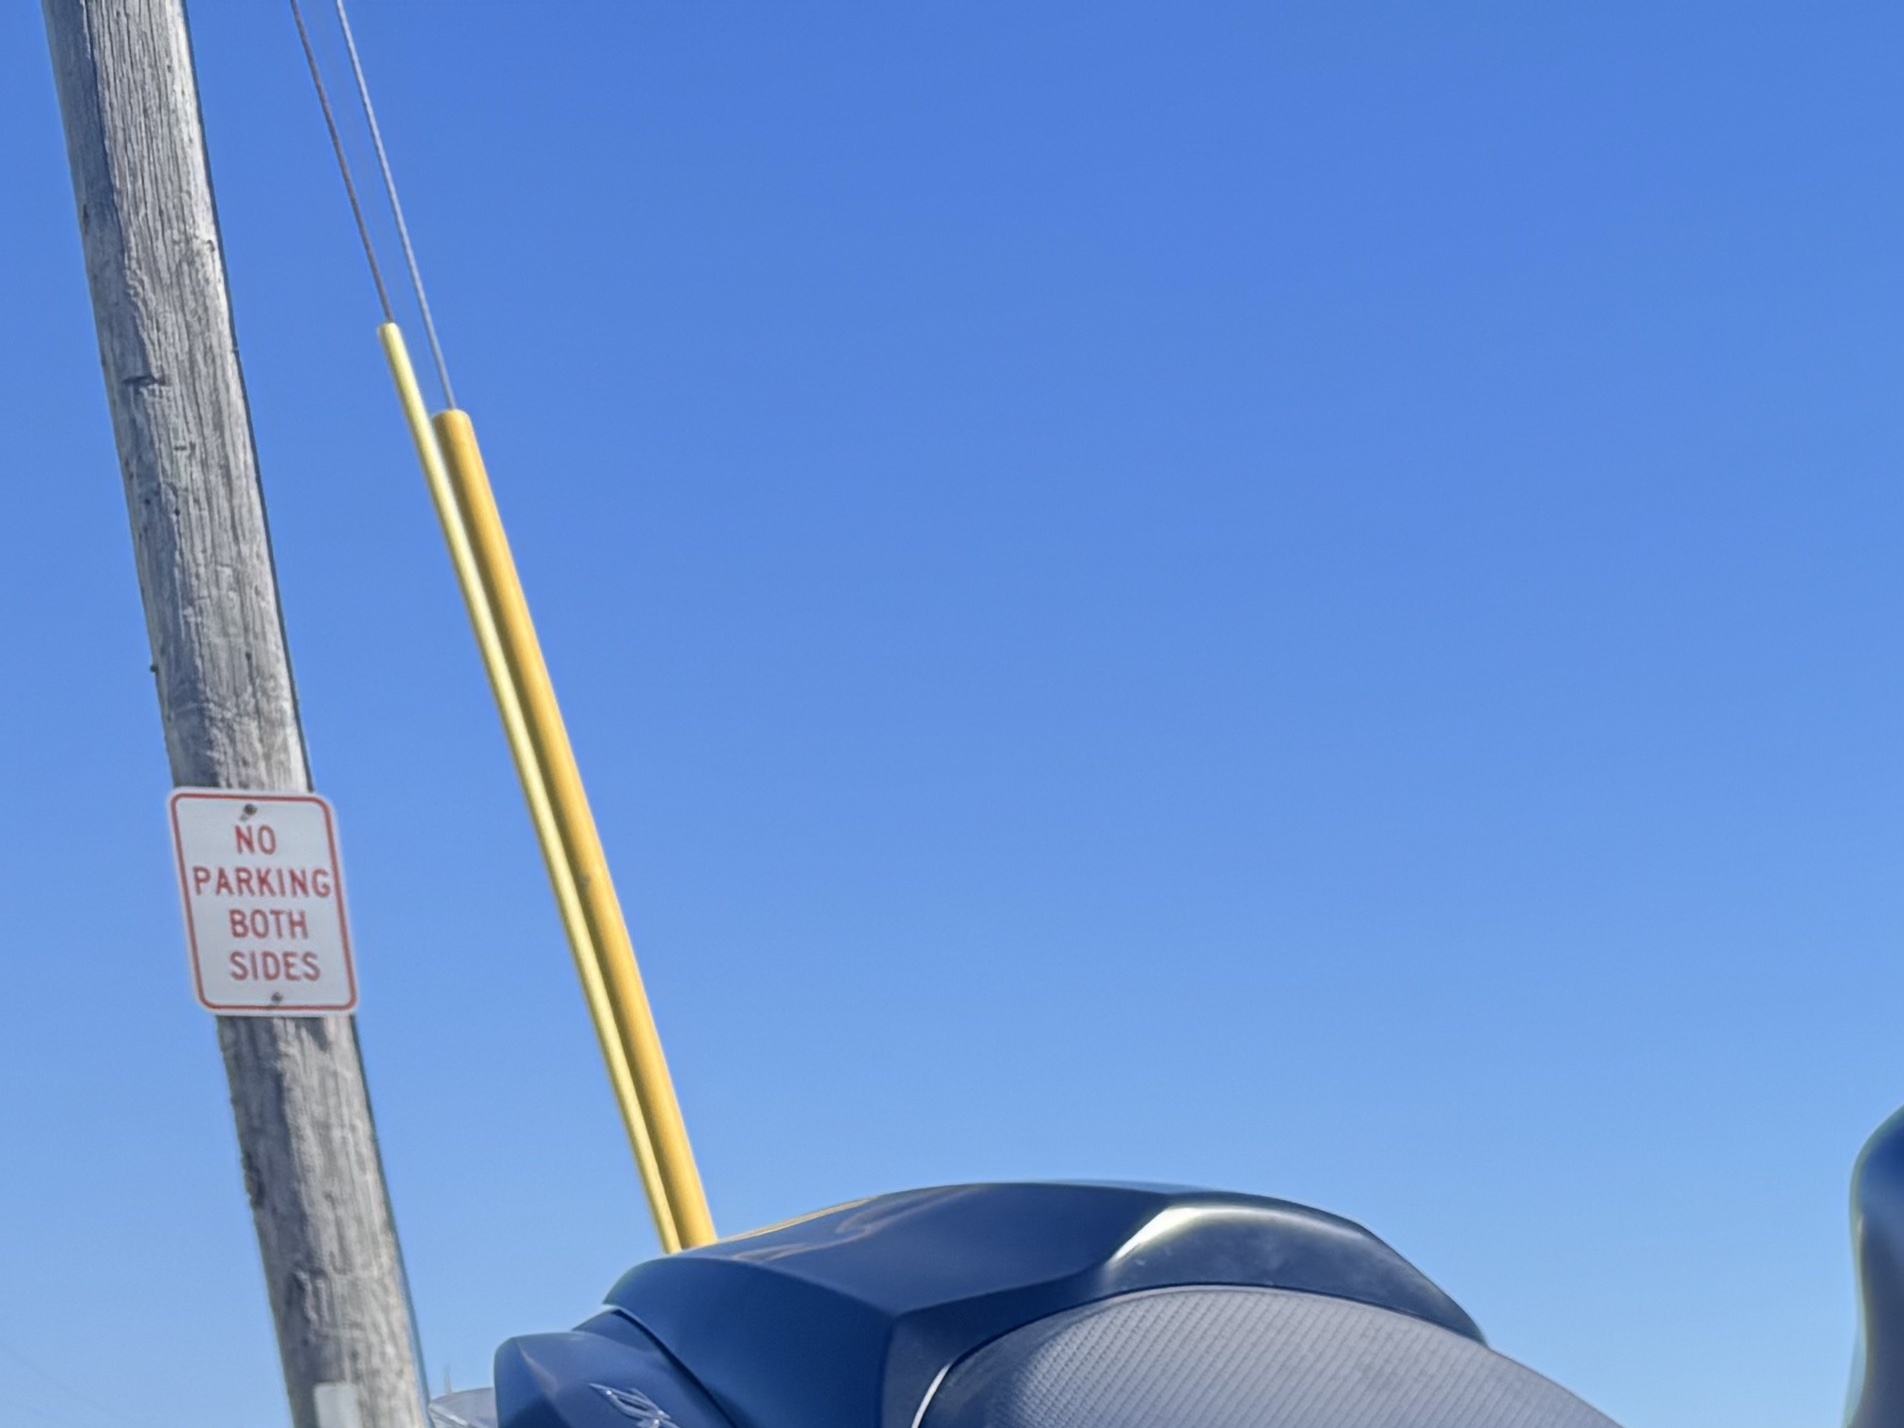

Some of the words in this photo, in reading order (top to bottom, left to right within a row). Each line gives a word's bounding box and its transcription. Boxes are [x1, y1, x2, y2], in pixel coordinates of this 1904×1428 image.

[234, 825, 277, 855] NO
[192, 866, 332, 898] PARKING
[228, 909, 309, 939] BOTH
[230, 951, 321, 981] SIDES
